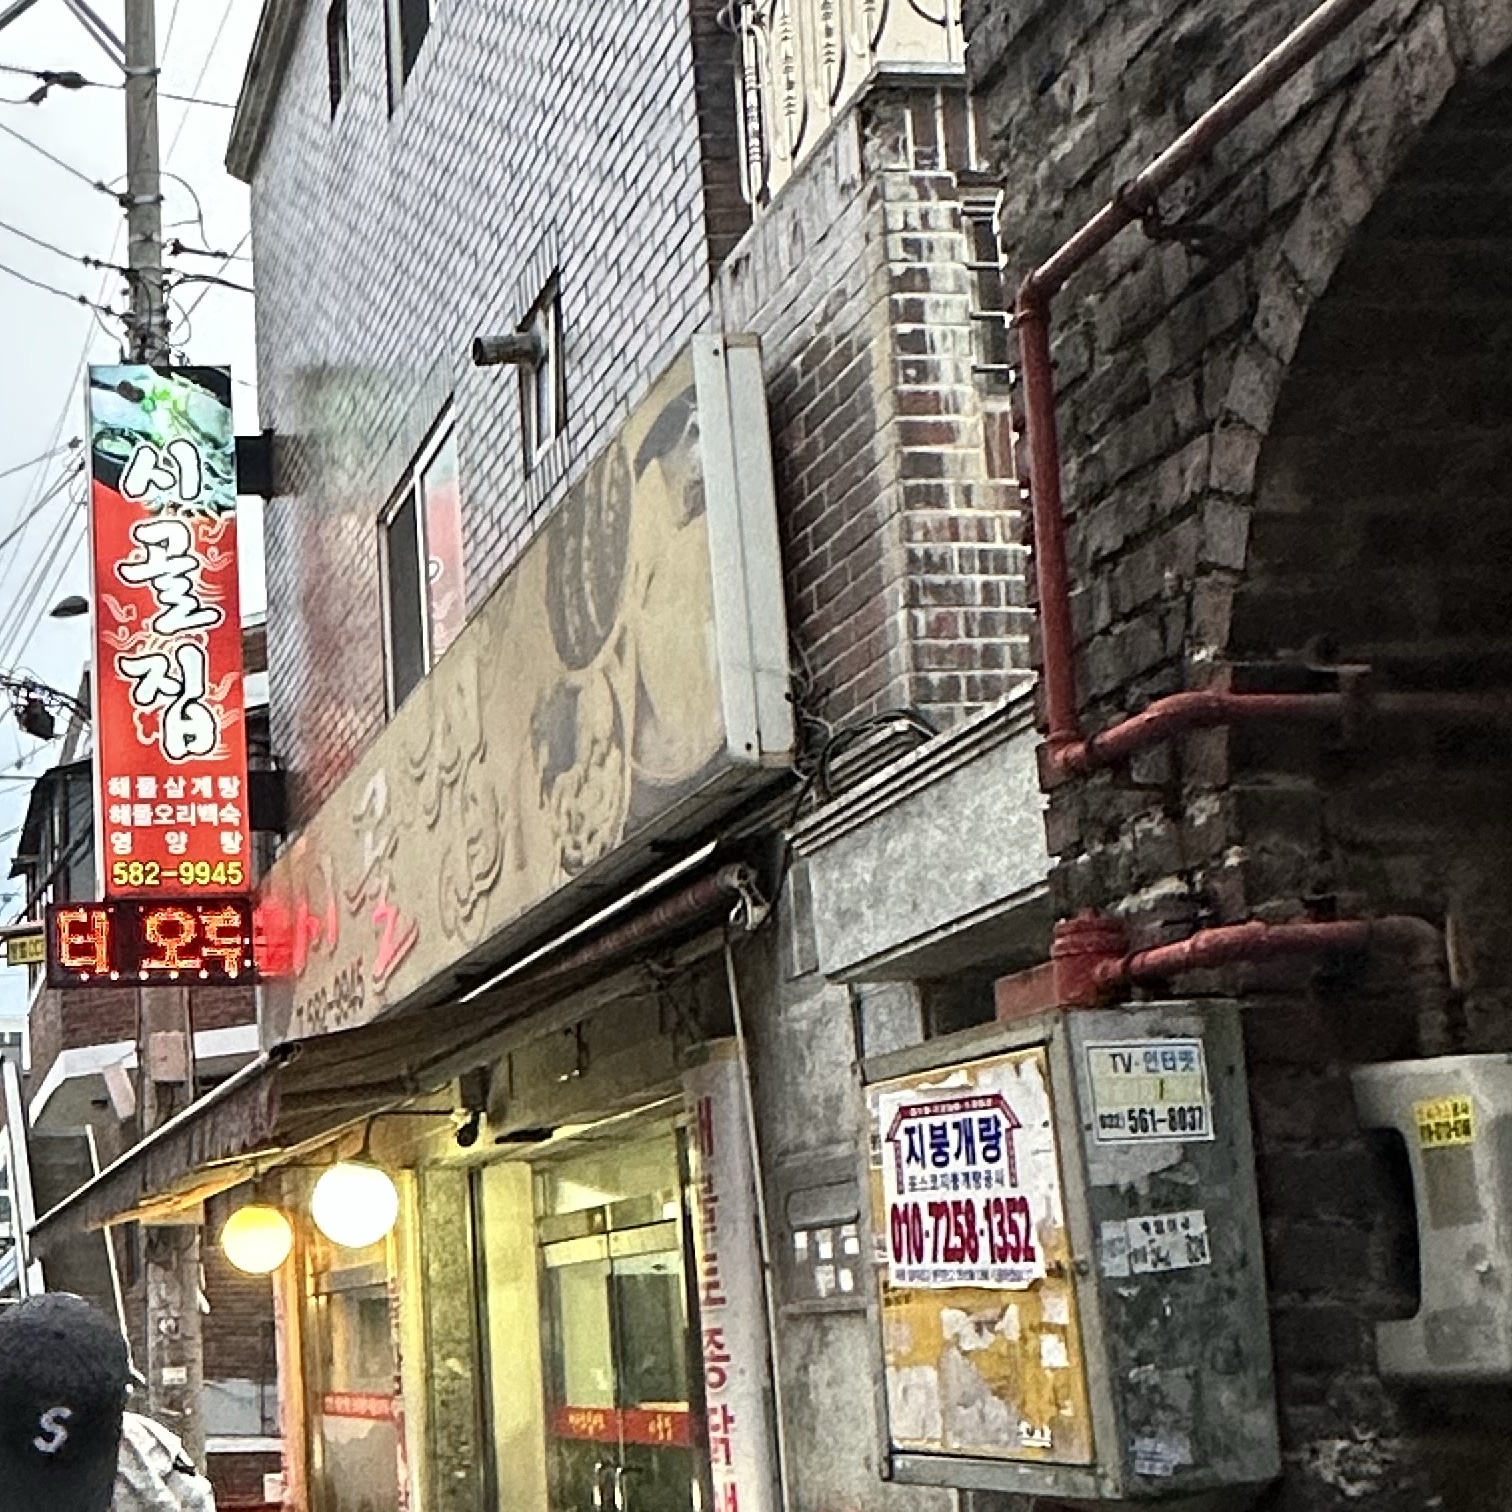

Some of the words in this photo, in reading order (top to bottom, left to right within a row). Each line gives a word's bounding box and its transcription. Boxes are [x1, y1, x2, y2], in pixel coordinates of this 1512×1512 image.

[117, 439, 223, 761] 시골집
[108, 775, 241, 799] 해물삼계탕
[108, 802, 242, 827] 해물오리백숙
[112, 861, 244, 886] 582-9945
[904, 1114, 1002, 1170] 지붕개량
[33, 1406, 72, 1453] S
